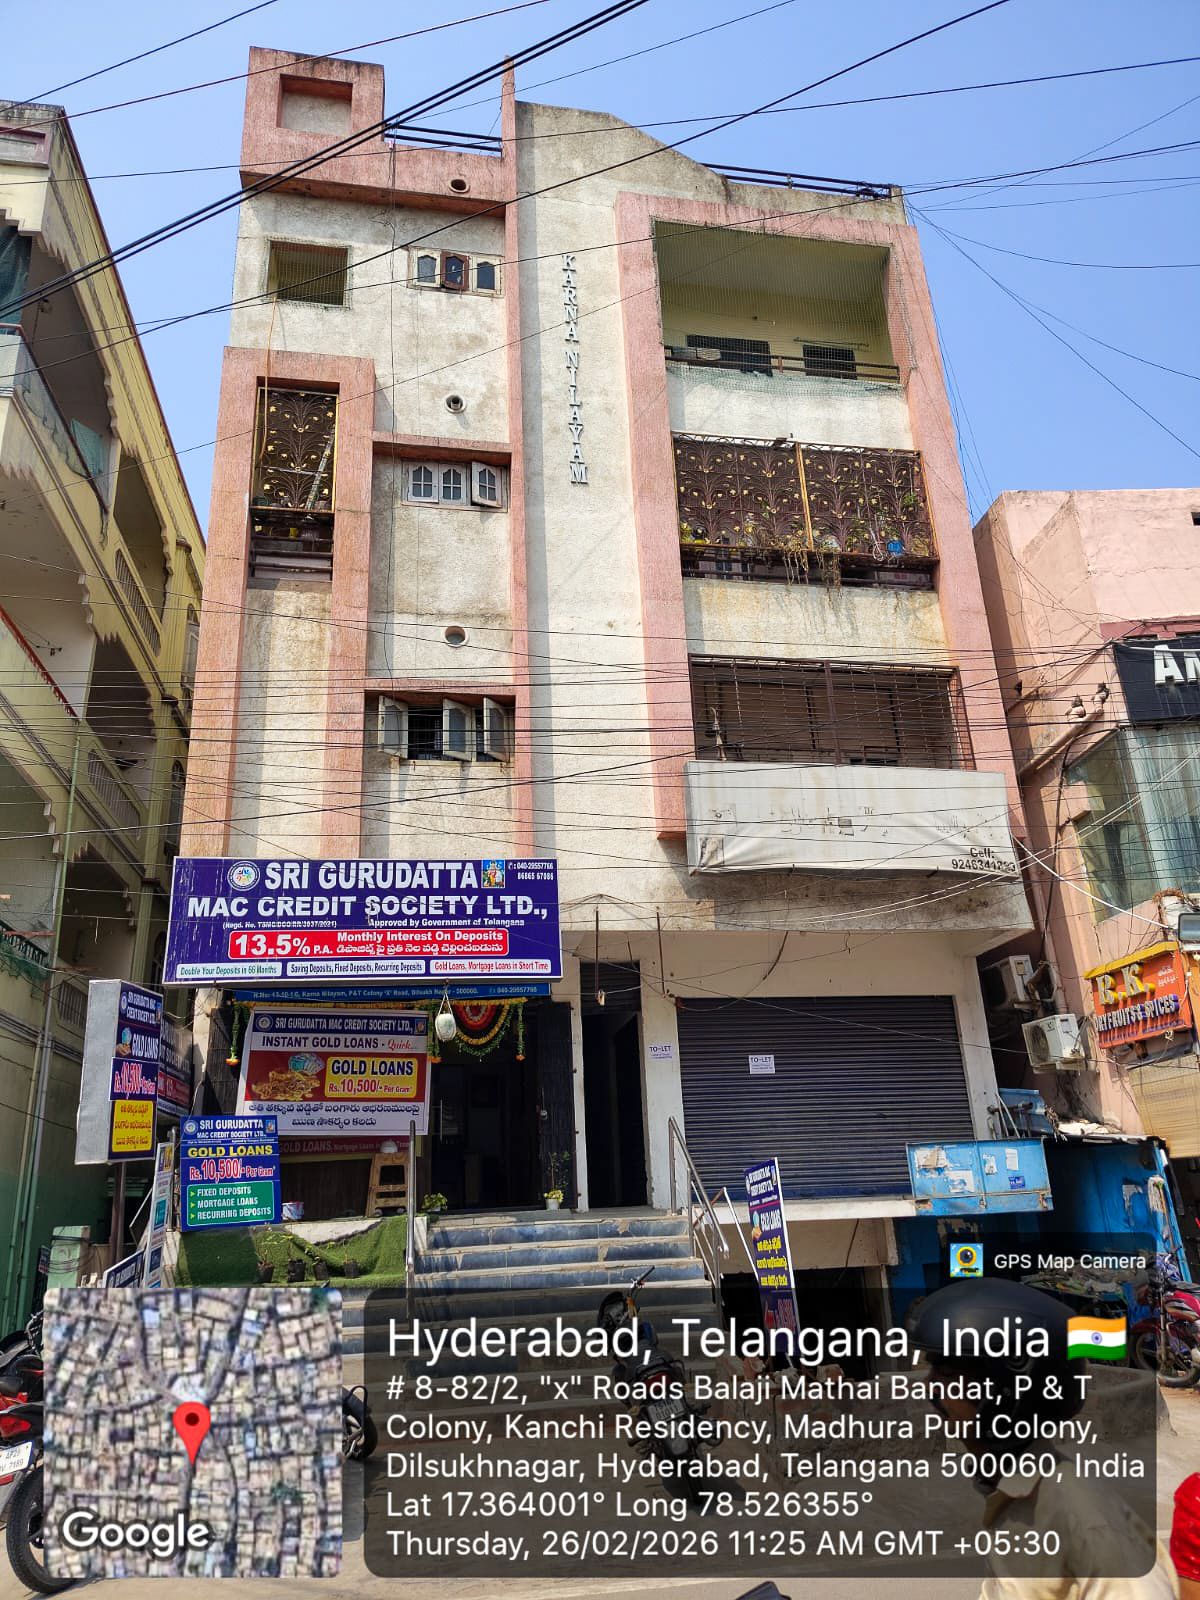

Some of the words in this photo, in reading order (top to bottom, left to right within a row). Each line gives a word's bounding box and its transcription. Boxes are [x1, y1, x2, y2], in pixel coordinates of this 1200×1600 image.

[562, 255, 580, 342] KARNA
[566, 350, 588, 484] NILAYAM
[970, 847, 994, 858] Cell:
[264, 861, 310, 890] SRI
[318, 861, 479, 890] GURUDATTA
[188, 896, 249, 918] MAC
[257, 895, 357, 917] CREDIT
[364, 895, 479, 916] SOCIETY
[486, 895, 548, 919] LTD.,
[369, 919, 408, 927] Approved
[409, 918, 420, 928] by
[421, 918, 471, 927] Government
[472, 918, 482, 926] of
[484, 918, 525, 928] Telangana
[337, 931, 383, 943] Monthly
[386, 931, 433, 941] Interest
[435, 931, 451, 941] On
[454, 931, 503, 943] Deposits
[234, 933, 310, 957] 13.5%
[313, 945, 333, 955] P.A.
[215, 965, 241, 976] Deposits
[256, 965, 277, 974] Months
[290, 963, 308, 974] Saving
[309, 963, 334, 975] Deposits,
[349, 962, 374, 974] Deposits,
[374, 962, 400, 973] Recurring
[400, 962, 423, 973] Deposits
[434, 962, 448, 970] Gold
[467, 961, 495, 972] Mortgage
[495, 961, 512, 970] Loans
[512, 961, 518, 969] in
[518, 961, 534, 970] Short
[534, 961, 549, 970] Time
[275, 1017, 287, 1029] SRI
[288, 1018, 327, 1030] GURUDATTA
[327, 1019, 343, 1030] MAC
[344, 1019, 368, 1030] CREDIT
[368, 1020, 396, 1031] SOCIETY
[262, 1036, 309, 1048] INSTANT
[311, 1037, 341, 1048] GOLD
[344, 1038, 379, 1049] LOANS
[649, 1045, 671, 1053] TO-LET
[331, 1060, 367, 1075] GOLD
[371, 1061, 414, 1076] LOANS
[328, 1083, 340, 1093] Rs.
[383, 1085, 395, 1093] Per
[199, 1119, 213, 1130] SRI
[215, 1119, 263, 1130] GURUDATTA
[209, 1131, 230, 1139] CREDIT
[187, 1147, 226, 1158] GOLD
[229, 1145, 273, 1156] LOANS
[189, 1166, 202, 1181] Rs.
[197, 1188, 217, 1197] FIXED
[219, 1186, 251, 1195] DEPOSITS
[197, 1199, 235, 1208] MORTGAGE
[236, 1197, 258, 1206] LOANS
[197, 1210, 238, 1220] RECURRING
[239, 1207, 272, 1217] DEPOSITS
